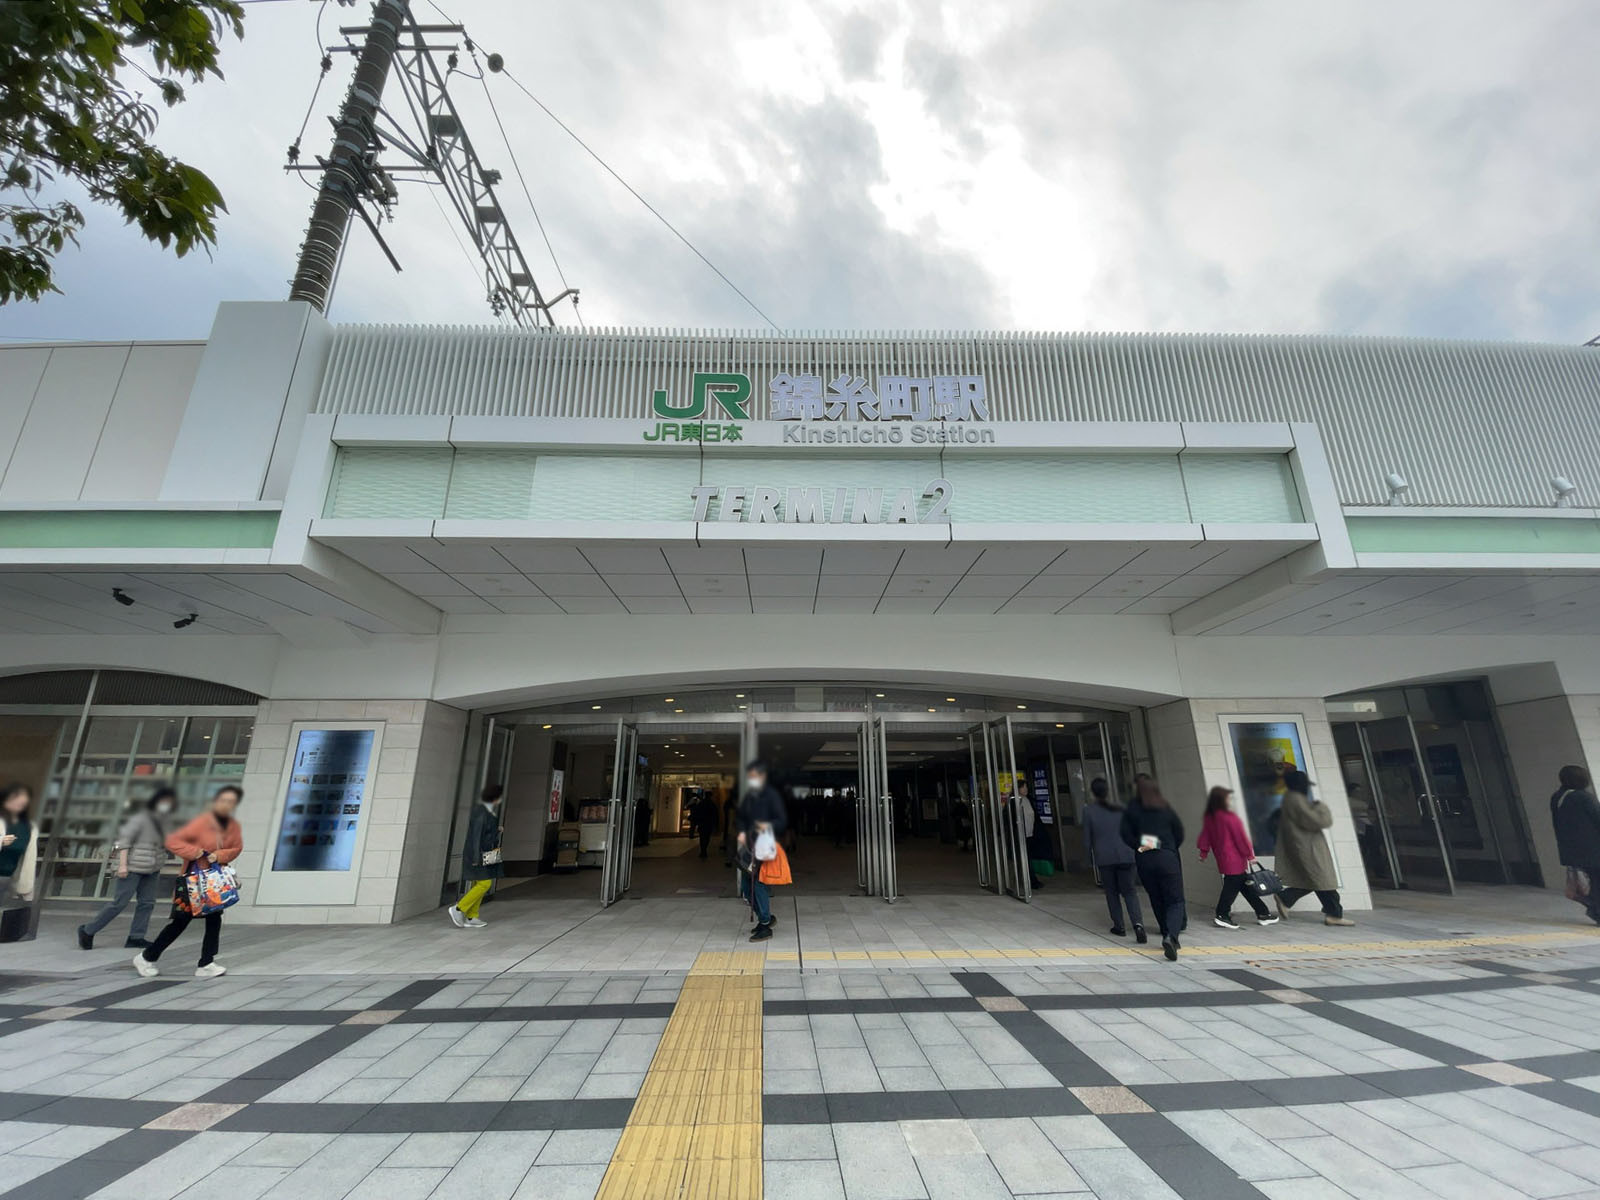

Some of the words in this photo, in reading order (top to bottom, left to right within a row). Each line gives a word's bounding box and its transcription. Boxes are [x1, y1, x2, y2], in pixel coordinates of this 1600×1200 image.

[653, 372, 752, 420] JR
[769, 373, 990, 421] 錦糸町駅
[643, 423, 743, 442] JR東日本
[784, 425, 903, 443] Kinshichō
[911, 426, 995, 443] Station
